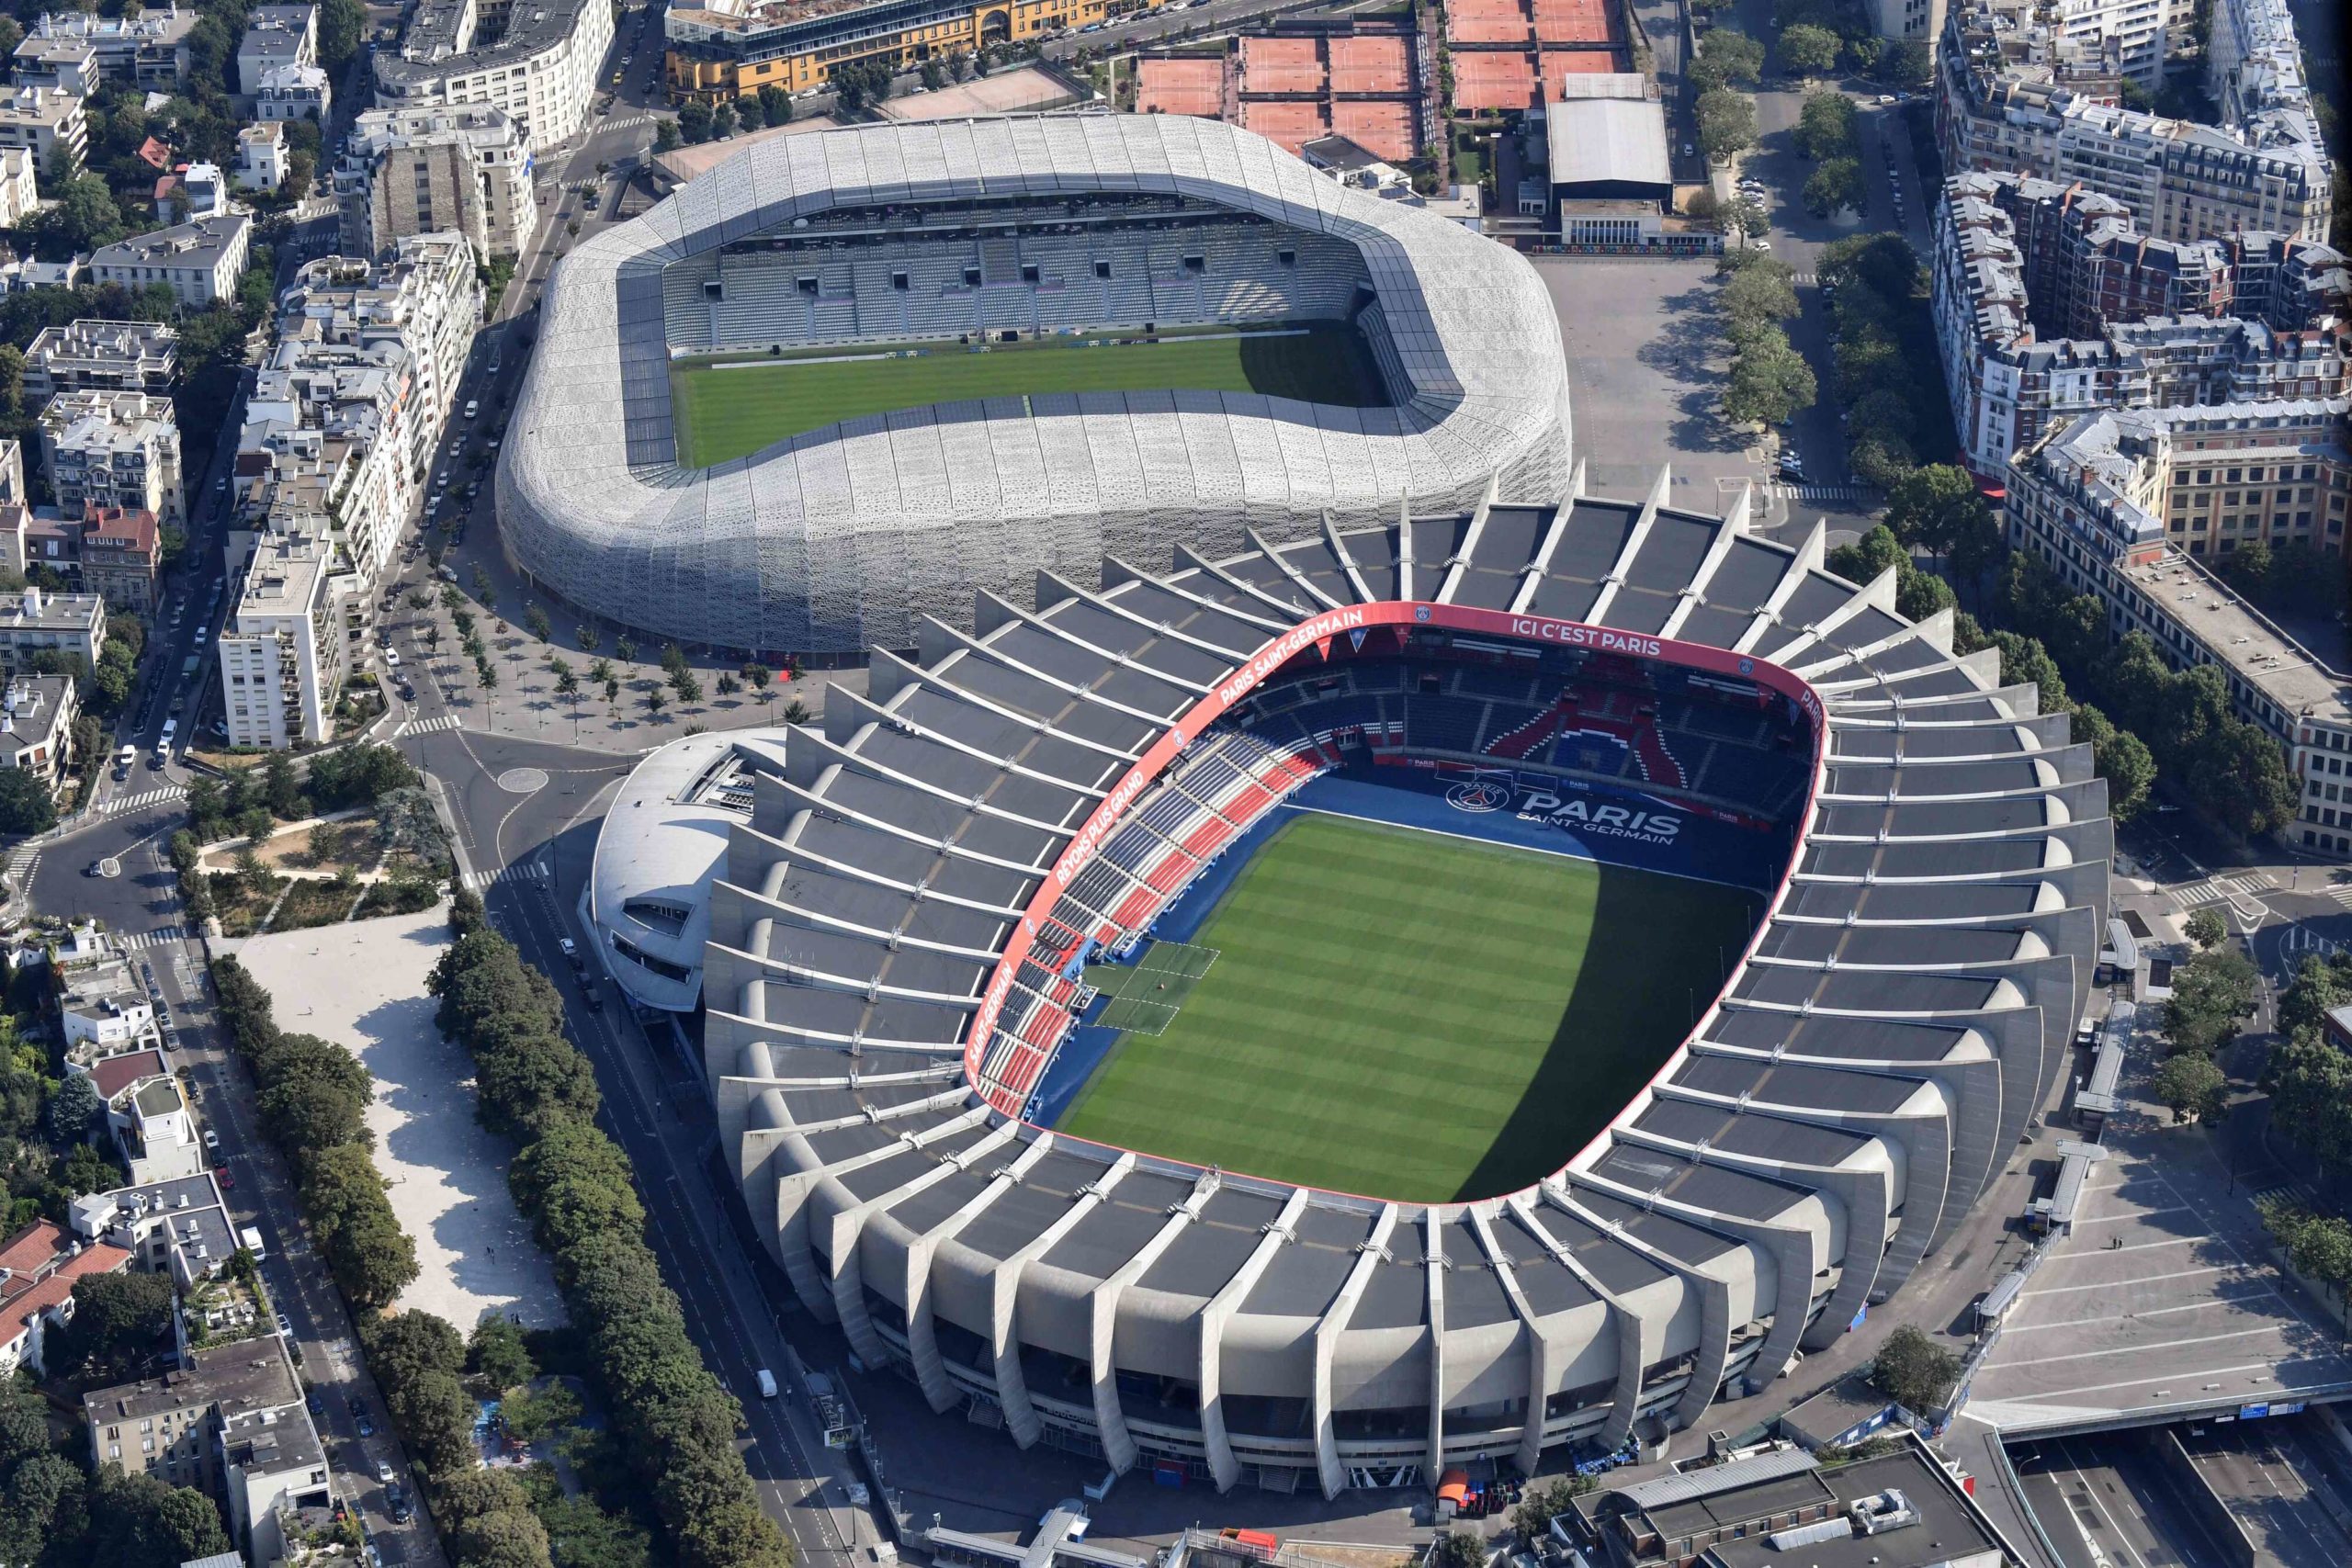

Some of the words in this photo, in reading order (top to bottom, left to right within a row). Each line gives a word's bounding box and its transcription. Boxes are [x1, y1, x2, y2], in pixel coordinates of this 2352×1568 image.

[1220, 671, 1254, 705] PARIS
[1254, 610, 1363, 677] SAINT-GERMAIN
[1512, 618, 1537, 636] ICI
[1542, 624, 1598, 645] C'EST
[1601, 634, 1661, 656] PARIS
[1801, 689, 1824, 728] PARIS
[1464, 783, 1502, 795] PARIS
[1056, 840, 1091, 886] RÊVONS
[1088, 807, 1114, 841] PLUS
[1110, 771, 1145, 812] GRAND
[1516, 812, 1675, 845] SAINT-GERMAIN
[1522, 791, 1682, 835] PARIS
[970, 961, 1013, 1066] SAINT-GERMAIN
